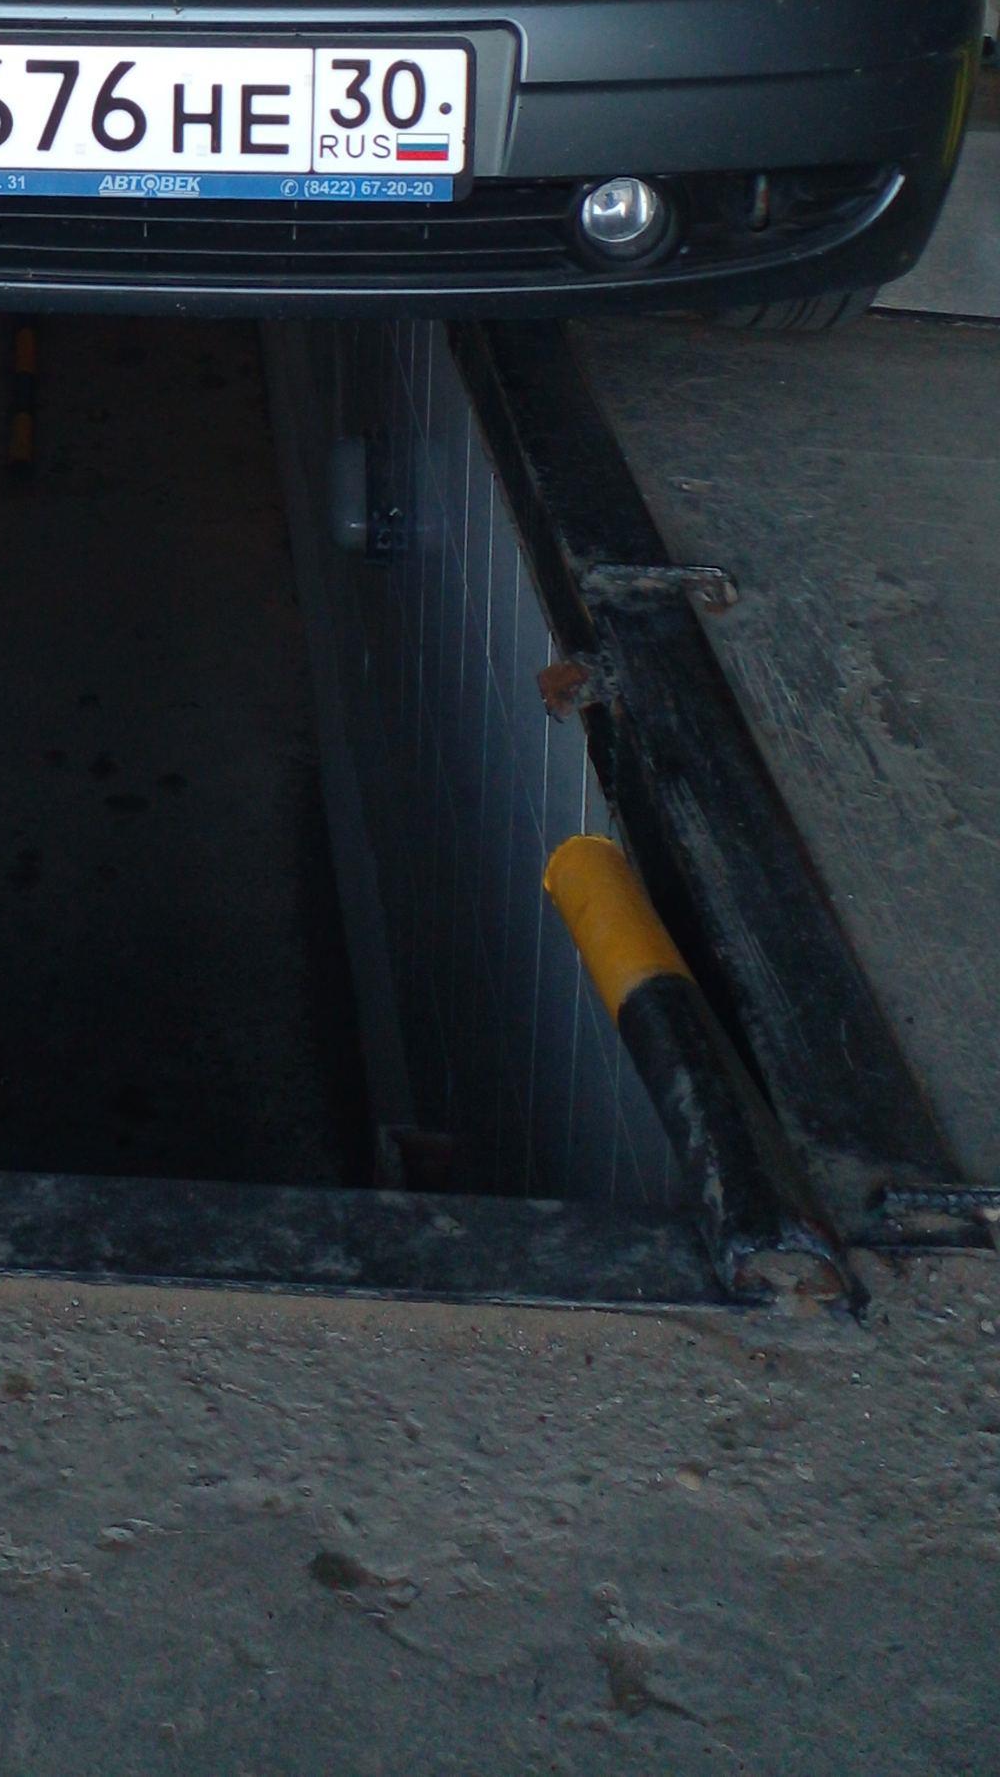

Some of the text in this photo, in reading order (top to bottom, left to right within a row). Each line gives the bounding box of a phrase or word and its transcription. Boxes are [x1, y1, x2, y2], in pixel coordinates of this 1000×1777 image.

[330, 59, 426, 129] 30
[319, 134, 391, 159] RUS
[7, 175, 26, 189] 31
[98, 174, 202, 194] АВТОВЕК
[303, 180, 434, 197] (8422) 67-20-20
